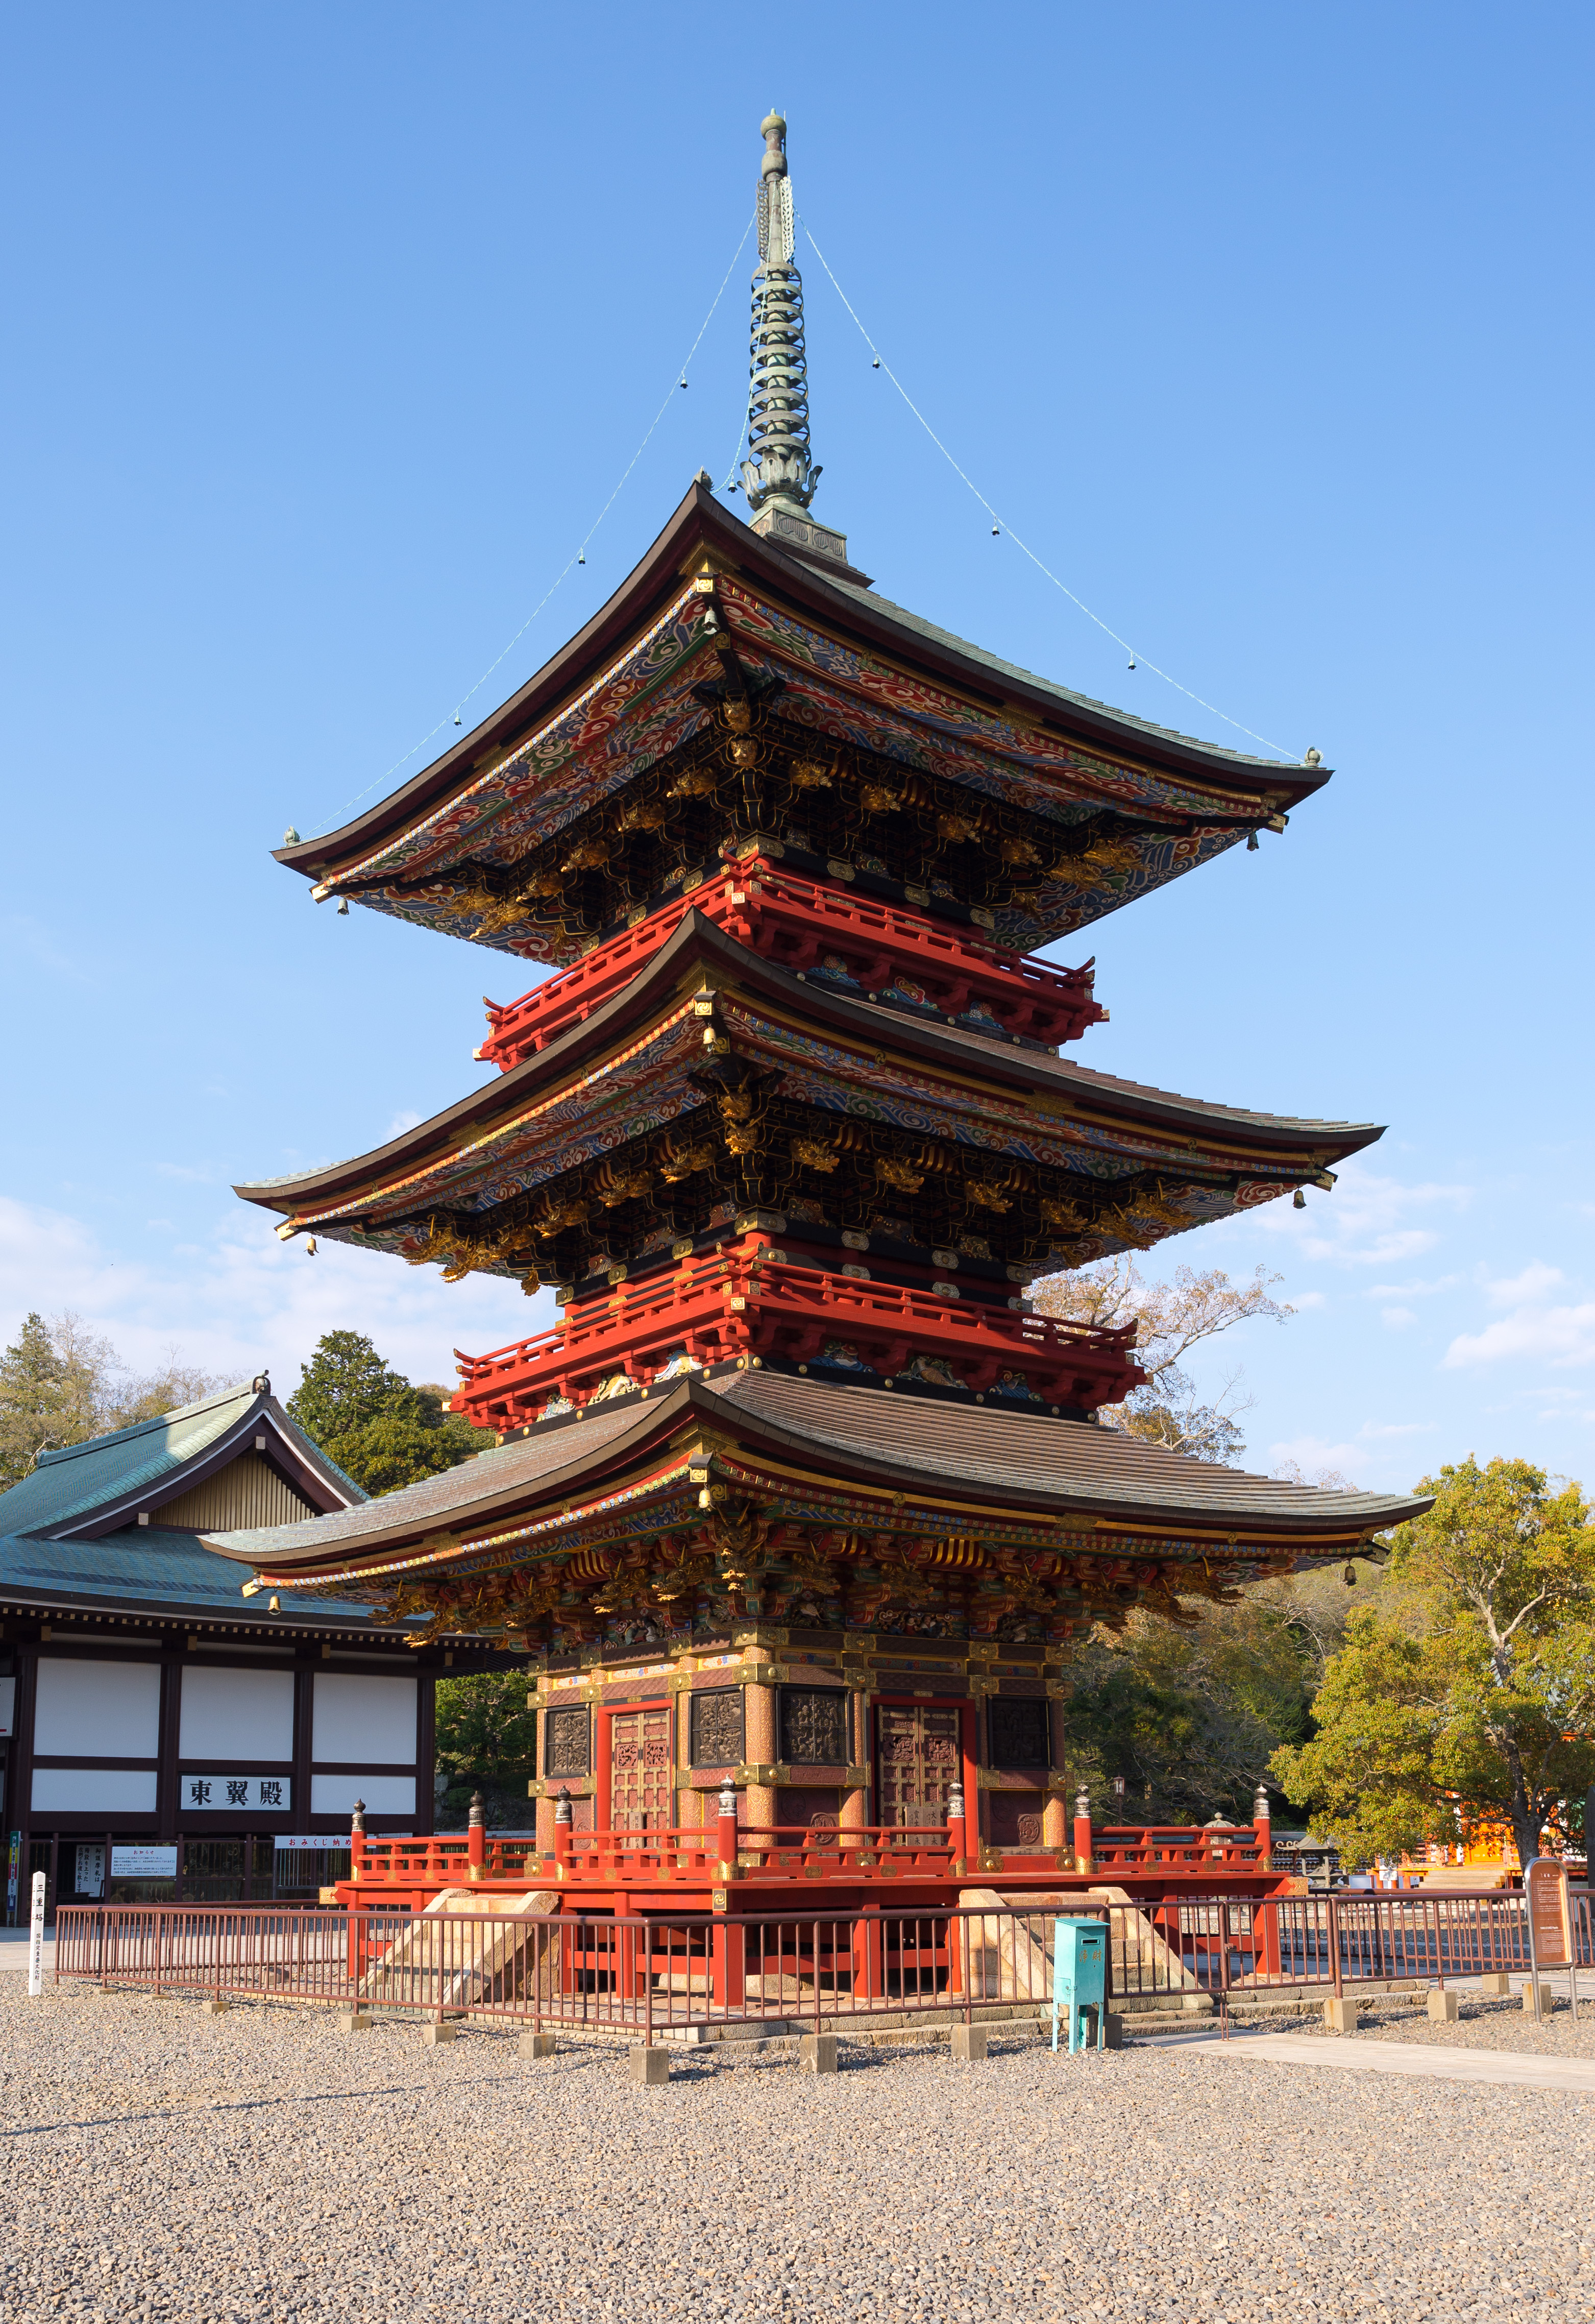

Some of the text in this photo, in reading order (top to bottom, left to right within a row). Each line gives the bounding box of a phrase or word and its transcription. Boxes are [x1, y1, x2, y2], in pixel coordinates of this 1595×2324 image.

[189, 1780, 283, 1806] 東翼殿
[35, 1884, 44, 1922] 三重塔
